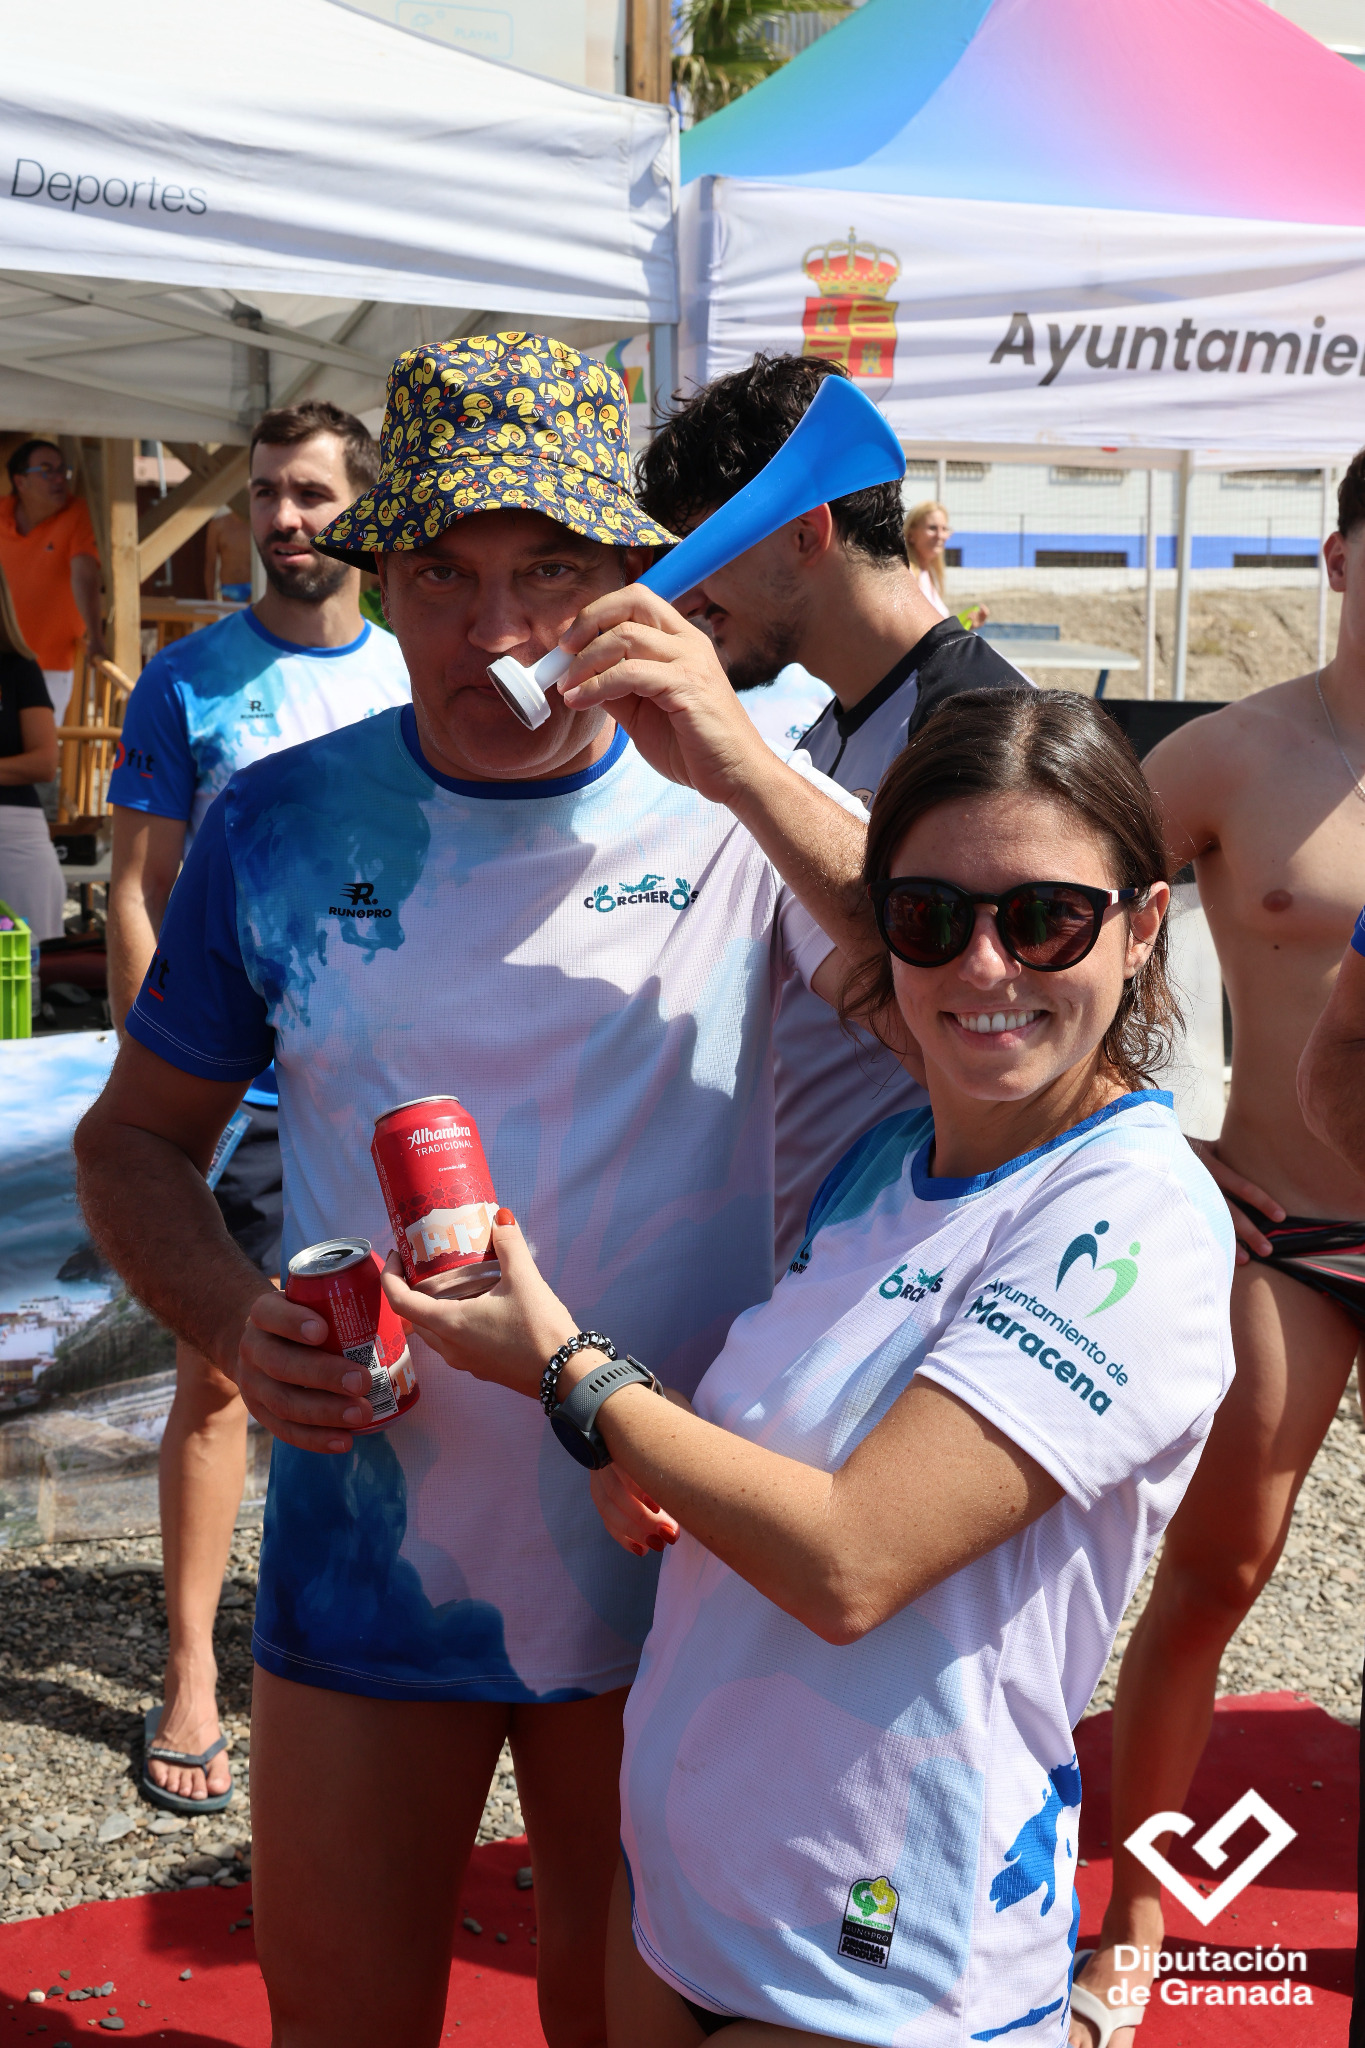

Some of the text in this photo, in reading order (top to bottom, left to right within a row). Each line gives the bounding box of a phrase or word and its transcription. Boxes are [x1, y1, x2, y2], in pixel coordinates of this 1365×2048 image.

[11, 158, 208, 215] Deportes
[989, 312, 1365, 386] Ayuntamie
[407, 1122, 471, 1150] Alhambra
[415, 1139, 473, 1157] TRADICIONAL
[964, 1295, 1113, 1416] Maracena
[984, 1278, 1129, 1387] Ayuntamiento de
